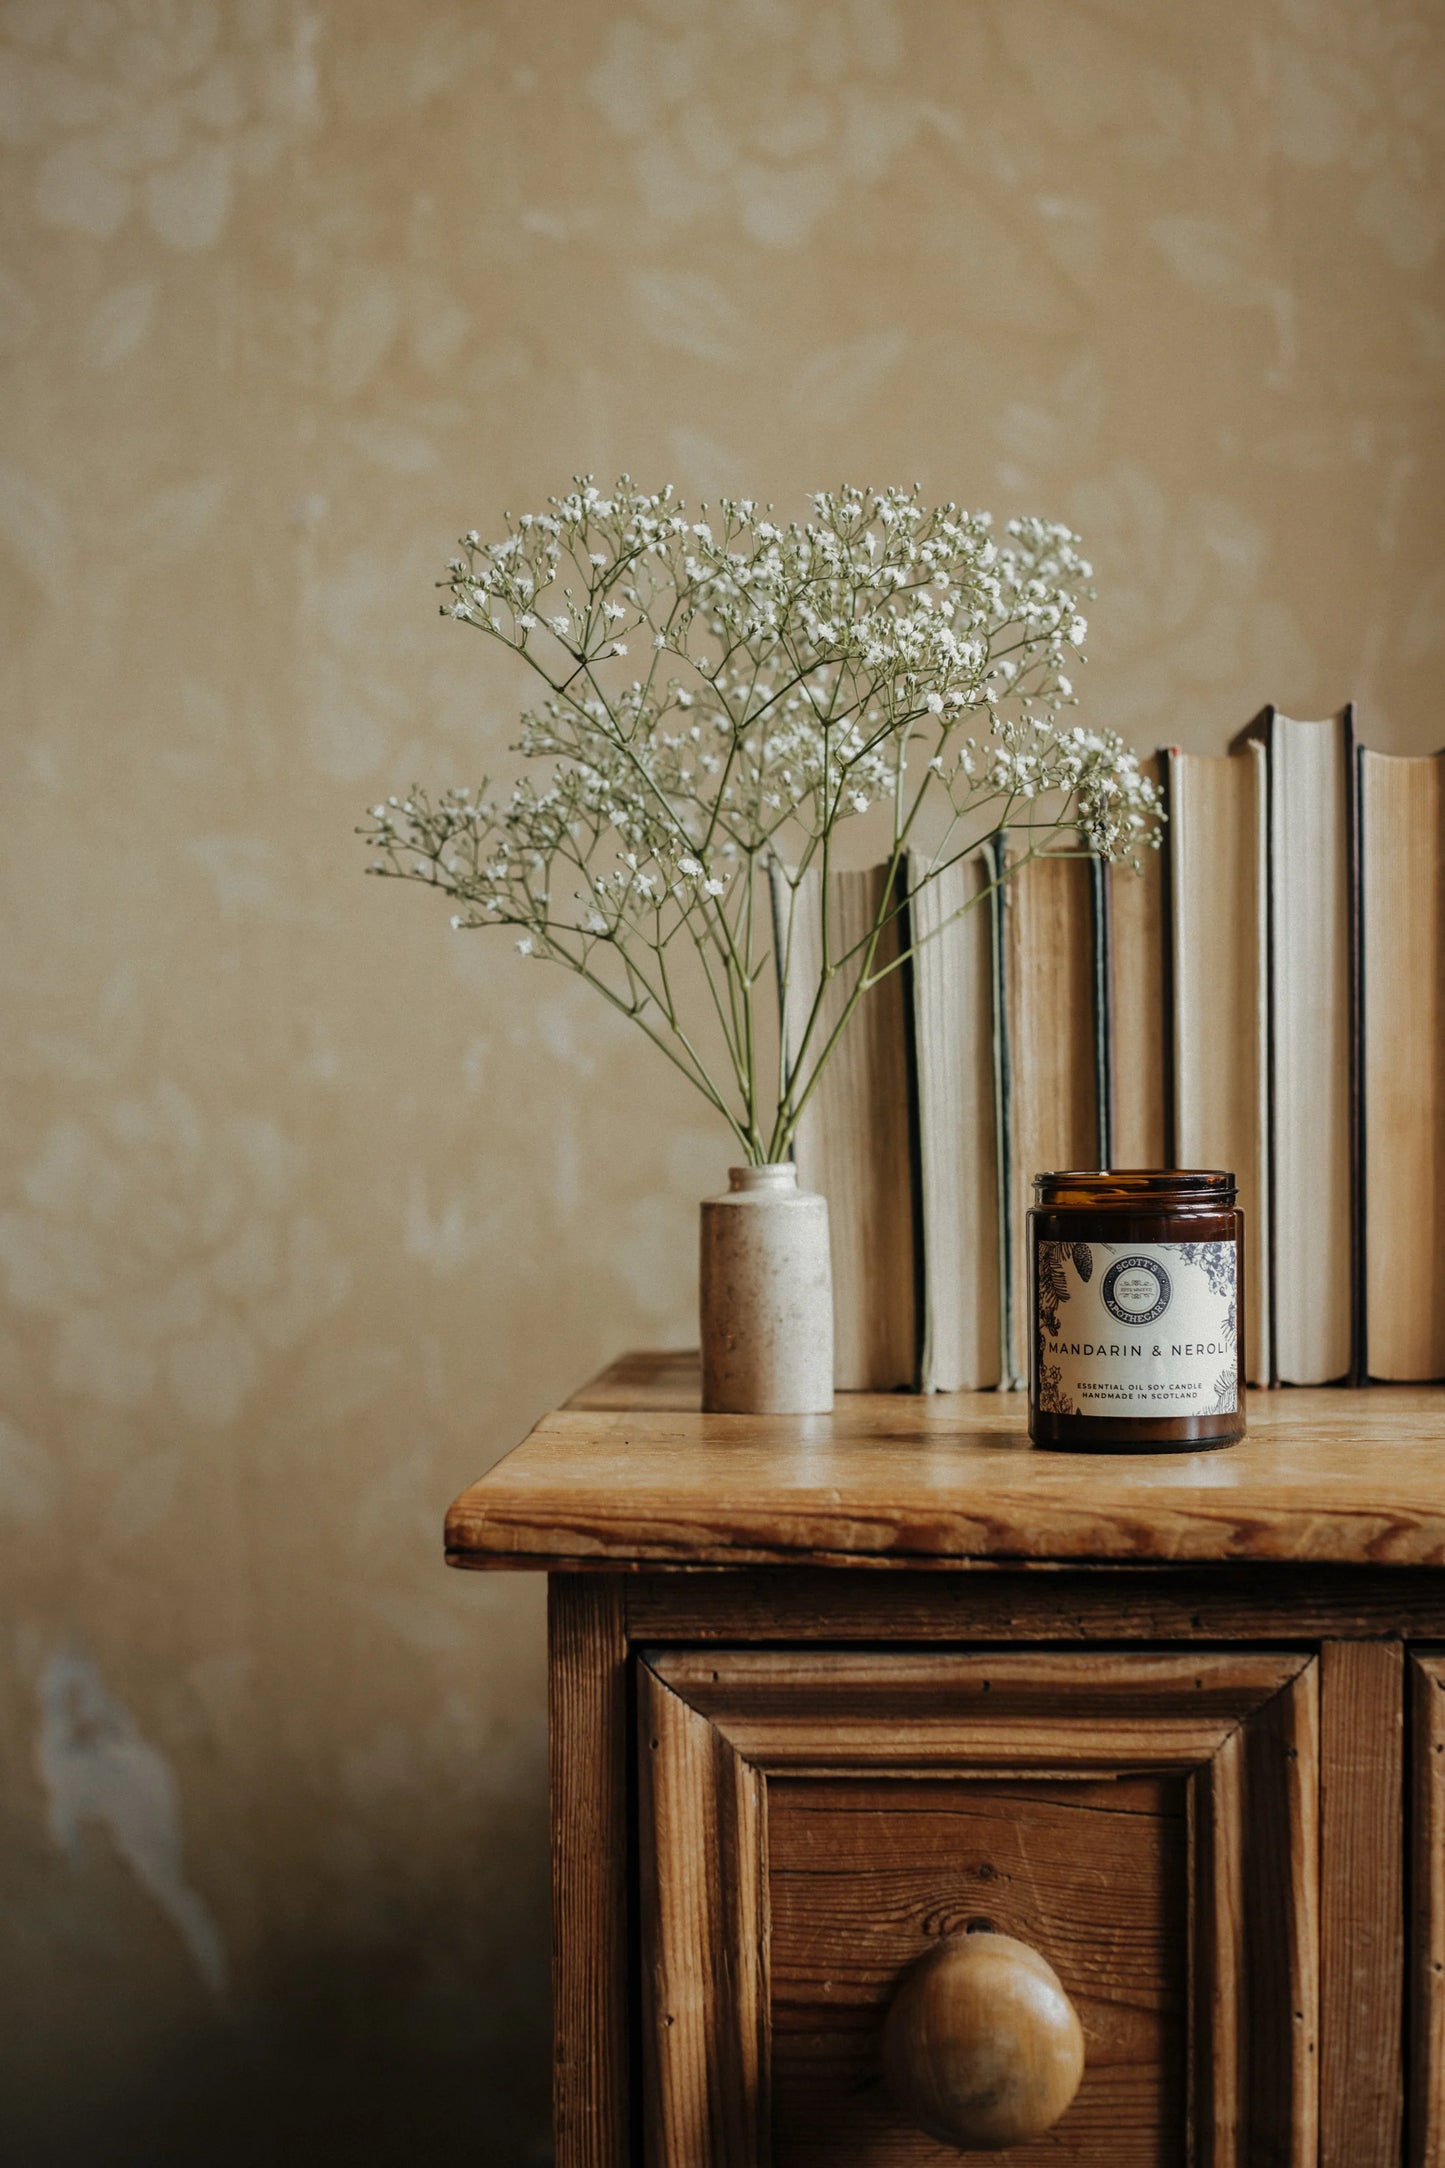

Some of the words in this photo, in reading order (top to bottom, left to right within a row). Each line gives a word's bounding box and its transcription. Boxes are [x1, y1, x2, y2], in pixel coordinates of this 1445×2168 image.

[1116, 1258, 1158, 1272] SCOTT'S
[1106, 1299, 1167, 1323] APOTHECARY
[1049, 1342, 1142, 1357] MANDARIN
[1152, 1345, 1162, 1357] &
[1171, 1342, 1228, 1356] NEROLI
[1077, 1382, 1124, 1391] ESSENTIAL
[1169, 1383, 1203, 1391] CANDLE
[1082, 1392, 1134, 1400] HANDMADE
[1151, 1392, 1198, 1400] SCOTLAND
